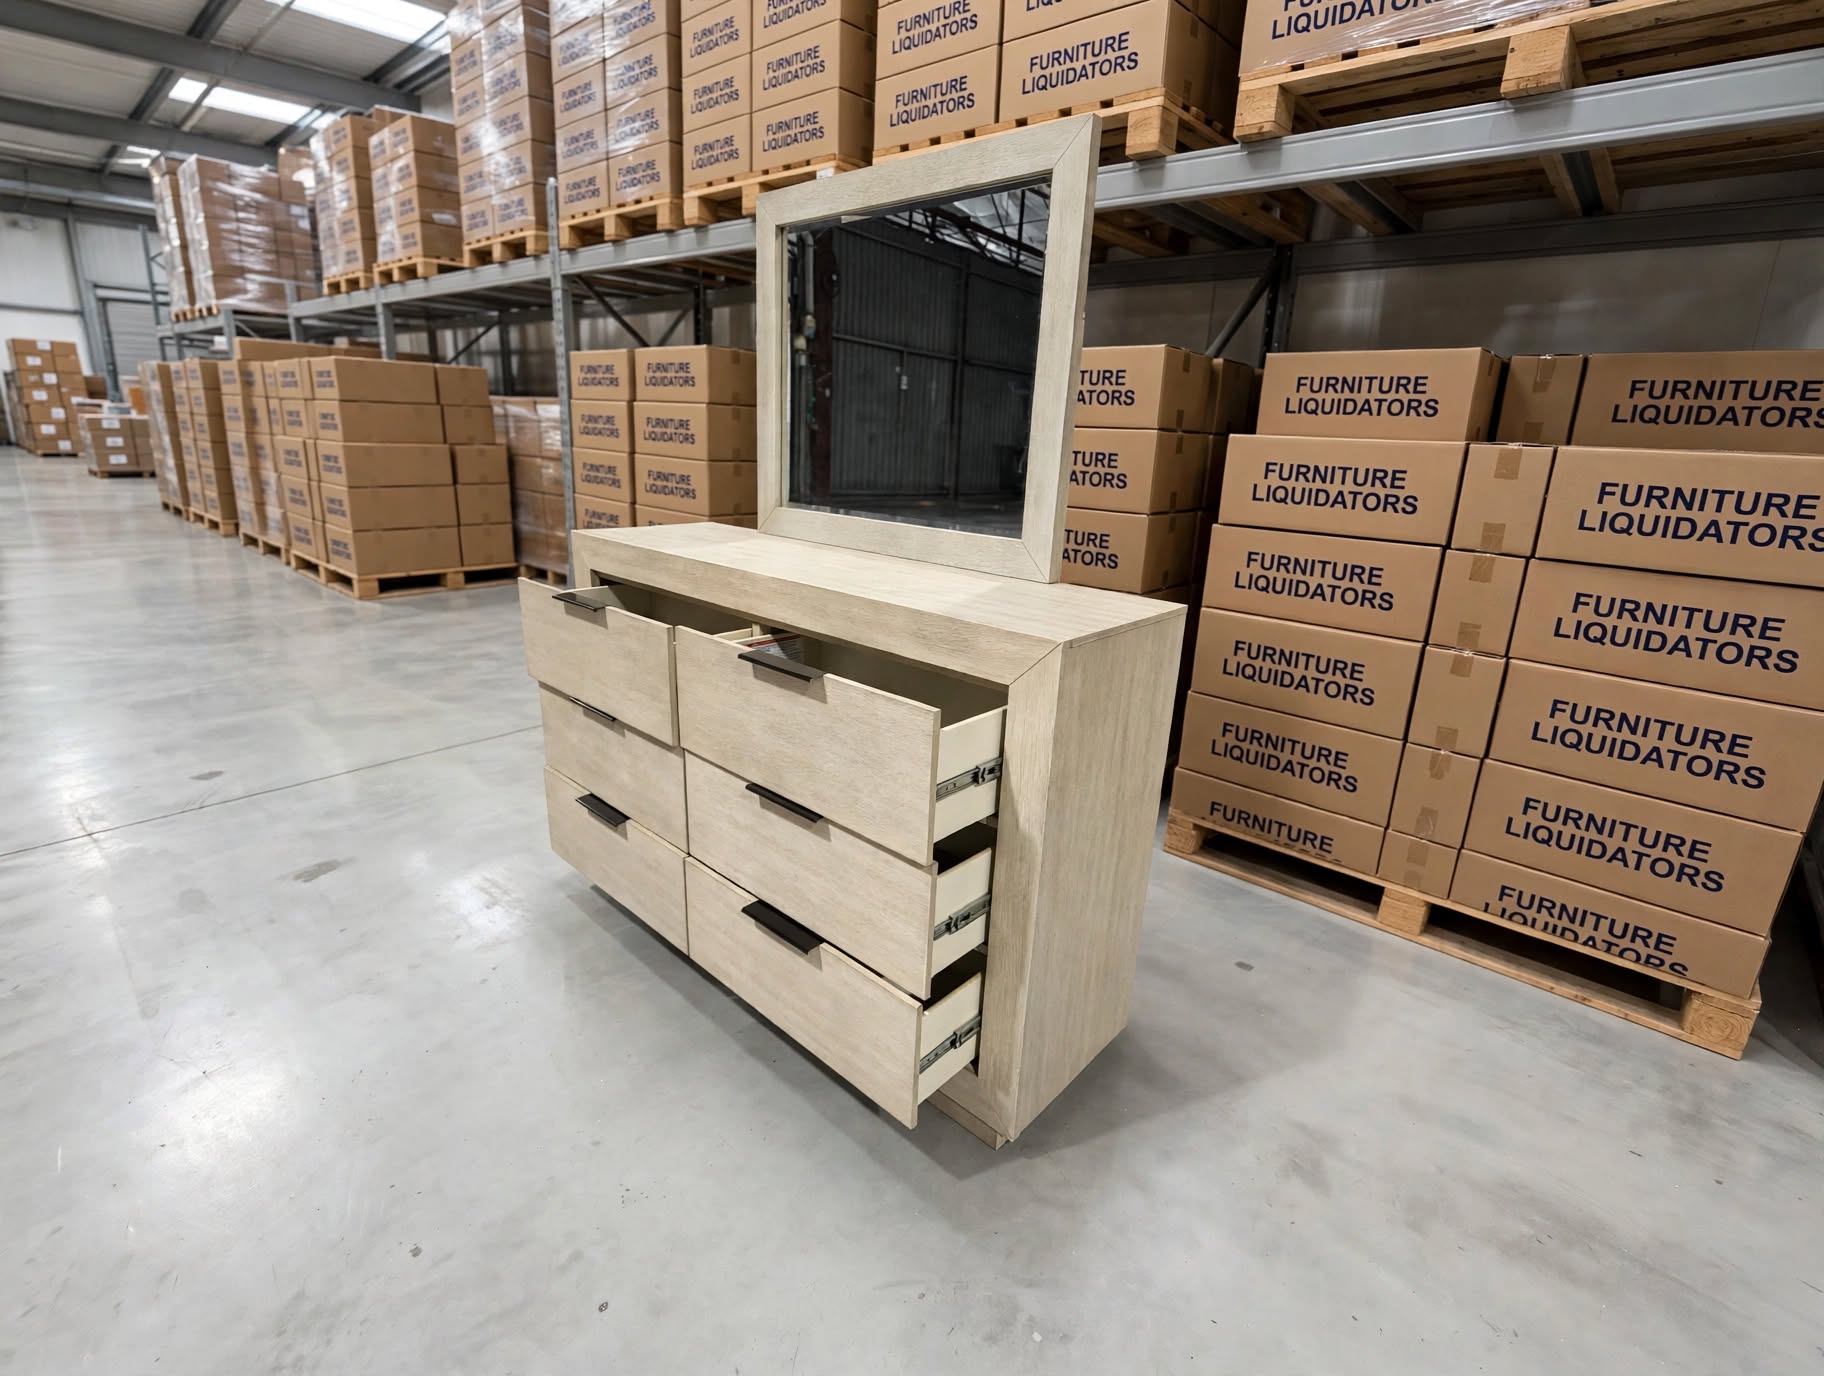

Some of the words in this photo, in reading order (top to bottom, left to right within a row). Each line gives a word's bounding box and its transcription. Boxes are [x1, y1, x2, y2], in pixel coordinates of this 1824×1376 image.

[693, 16, 735, 43] FURNITURE
[892, 13, 978, 54] LIQUIDATORS
[897, 0, 971, 35] FURNITURE
[1271, 0, 1442, 40] LIQUIDATO
[690, 29, 739, 58] LIQUIDATORS
[766, 45, 820, 75] FURNITURE
[1030, 31, 1130, 73] FURNITURE
[694, 76, 735, 99] FURNITURE
[762, 60, 826, 91] LIQUIDATORS
[1021, 52, 1139, 95] LIQUIDATORS
[690, 89, 739, 114] LIQUIDATORS
[895, 75, 968, 109] FURNITURE
[766, 111, 819, 136] FURNITURE
[889, 93, 975, 128] LIQUIDATORS
[694, 135, 735, 156] FURNITURE
[762, 126, 825, 152] LIQUIDATORS
[691, 148, 740, 170] LIQUIDATORS
[644, 375, 696, 388] LIQUIDATORS
[647, 362, 691, 374] FURNITURE
[1295, 375, 1428, 394] FURNITURE
[1628, 379, 1824, 401] FURNITURE
[646, 417, 691, 430] FURNITURE
[1284, 397, 1439, 418] LIQUIDATORS
[643, 432, 696, 445] LIQUIDATORS
[645, 482, 697, 499] LIQUIDATORS
[647, 469, 692, 484] FURNITURE
[1263, 461, 1408, 490] FURNITURE
[1252, 483, 1419, 515] LIQUIDATORS
[1597, 481, 1822, 520] FURNITURE
[1578, 508, 1824, 553] LIQUIDATORS
[1246, 551, 1384, 586] FURNITURE
[1234, 571, 1395, 611] LIQUIDATORS
[1571, 591, 1786, 642] FURNITURE
[1233, 640, 1366, 682] FURNITURE
[1553, 617, 1800, 674] LIQUIDATORS
[1222, 658, 1376, 706] LIQUIDATORS
[1221, 722, 1349, 770] FURNITURE
[1549, 699, 1753, 759] FURNITURE
[1211, 739, 1359, 793] LIQUIDATORS
[1531, 721, 1767, 789] LIQUIDATORS
[1209, 801, 1334, 854] FURNITURE
[1521, 797, 1713, 864] FURNITURE
[1505, 816, 1725, 893] LIQUIDATORS
[1498, 884, 1677, 955] FURNITURE
